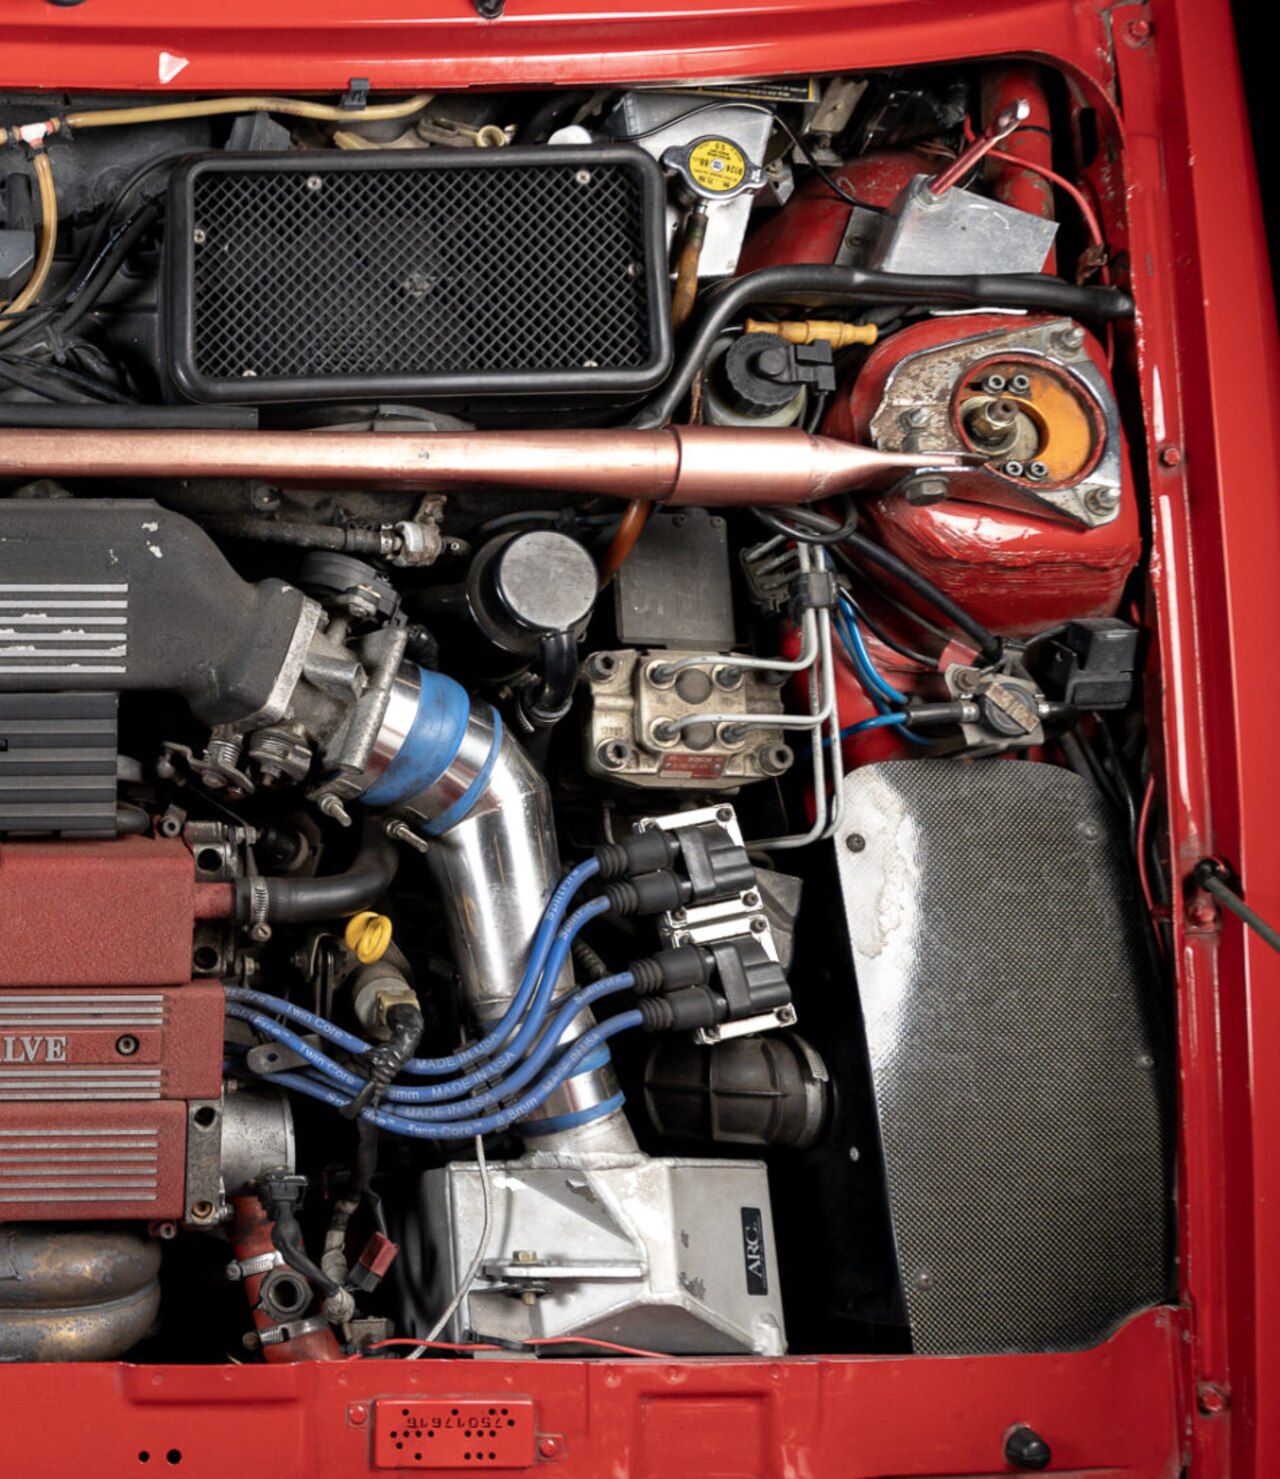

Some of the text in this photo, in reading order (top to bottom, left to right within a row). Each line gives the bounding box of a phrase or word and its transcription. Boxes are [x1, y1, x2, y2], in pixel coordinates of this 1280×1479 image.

[287, 1004, 313, 1024] Twin
[299, 1043, 325, 1066] Twin
[415, 1033, 500, 1069] MADE IN USA
[406, 1123, 436, 1135] Twin
[542, 1060, 570, 1093] MADE
[569, 1045, 585, 1064] IN
[581, 1032, 602, 1051] USA
[431, 1078, 472, 1098] MADE
[473, 1069, 489, 1083] IN
[489, 1051, 516, 1073] USA
[405, 1105, 445, 1118] MADE
[446, 1103, 462, 1116] IN
[467, 1091, 497, 1111] USA
[746, 1226, 763, 1279] ARC
[407, 1417, 503, 1429] 75017616
